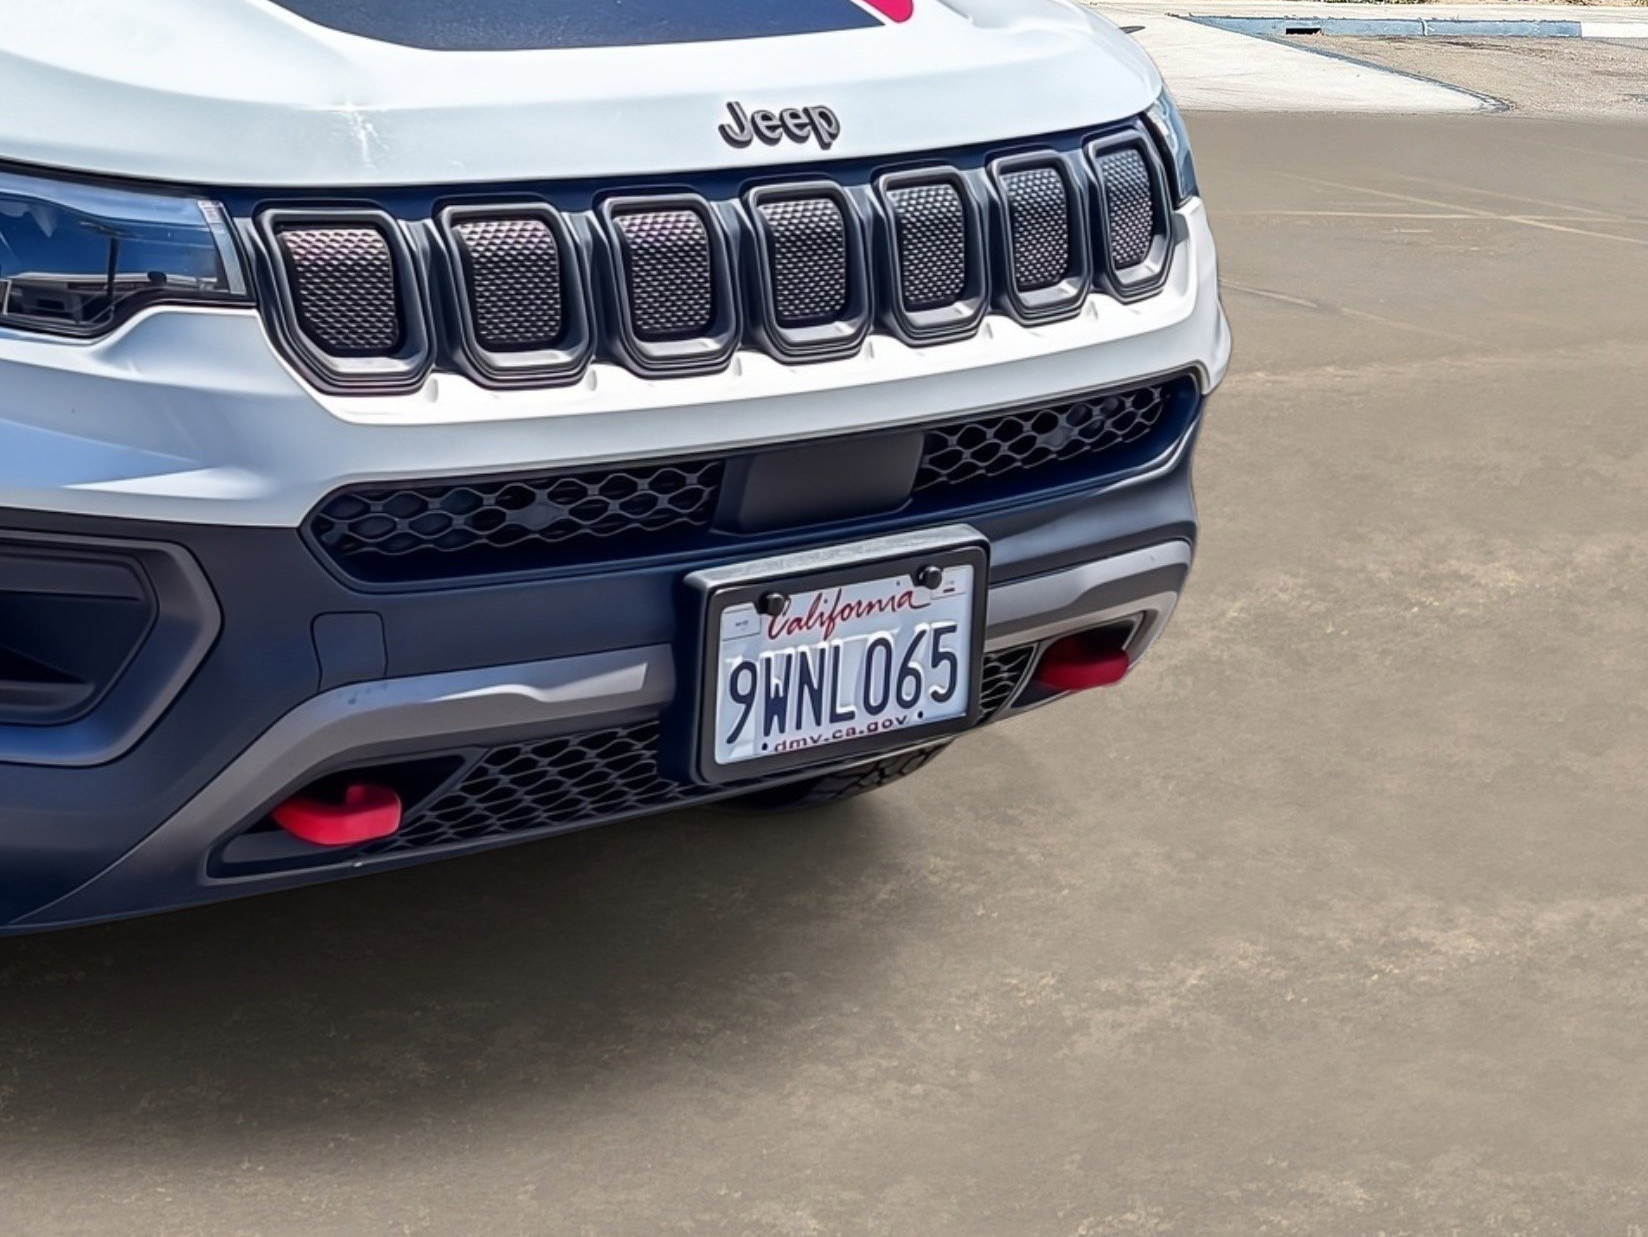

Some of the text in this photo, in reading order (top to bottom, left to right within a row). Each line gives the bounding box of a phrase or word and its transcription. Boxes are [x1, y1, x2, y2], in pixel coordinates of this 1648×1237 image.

[718, 101, 841, 151] Jeep
[767, 588, 932, 642] California
[725, 622, 959, 745] 9WNL065
[773, 714, 909, 754] dmv.ca.gov
